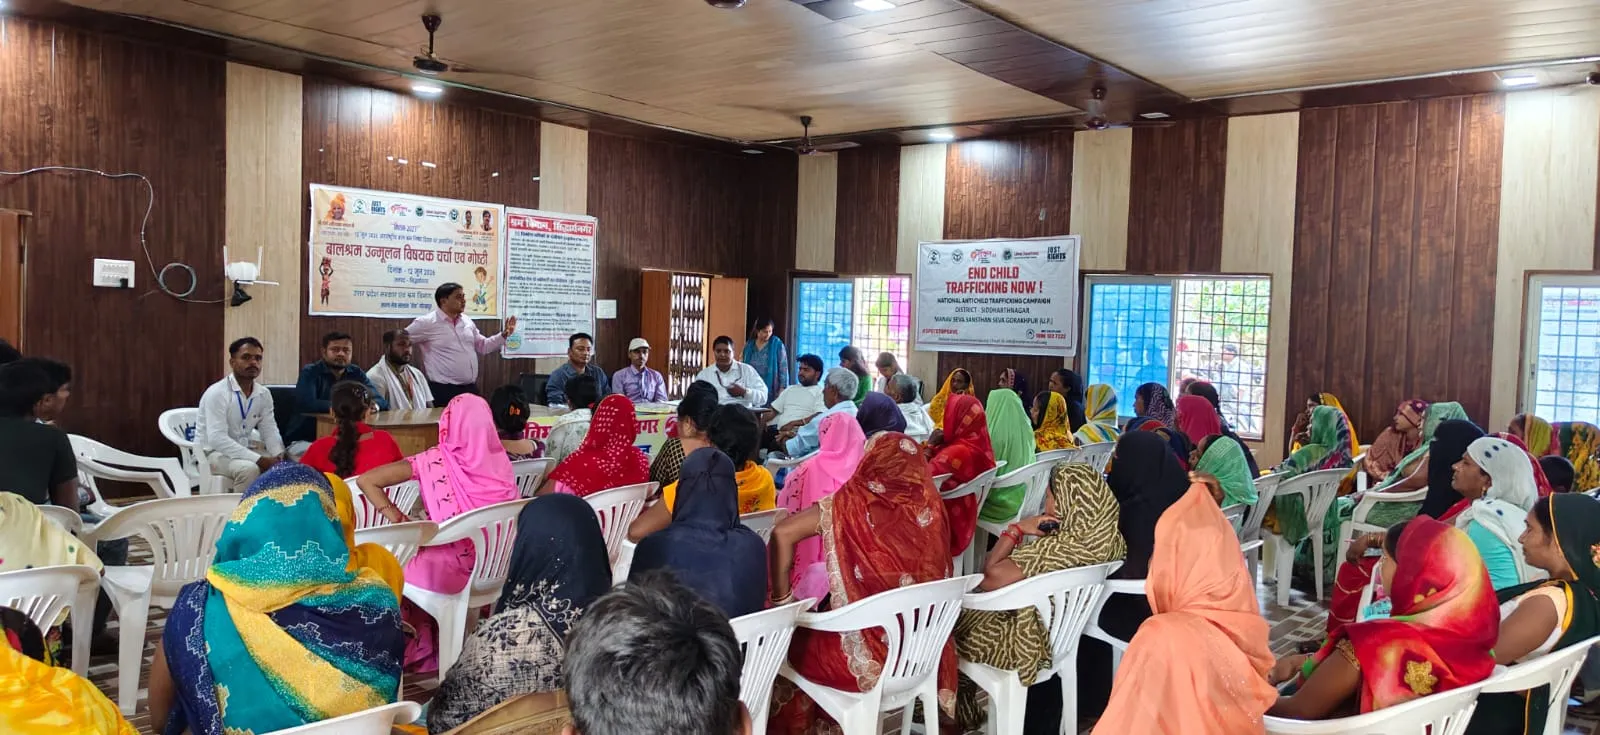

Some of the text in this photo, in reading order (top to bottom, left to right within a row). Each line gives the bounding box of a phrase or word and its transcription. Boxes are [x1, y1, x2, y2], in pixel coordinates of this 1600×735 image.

[325, 243, 362, 257] बालश्रम
[365, 245, 401, 263] उन्मूलन
[403, 244, 434, 261] विषयक
[436, 246, 453, 263] चर्चा
[1047, 252, 1066, 260] RIGHTS
[968, 266, 1019, 279] END CHILD
[945, 281, 1008, 294] TRAFFICKING
[1011, 281, 1036, 293] NOW
[981, 306, 1030, 314] SIDDHARTHNAGAR
